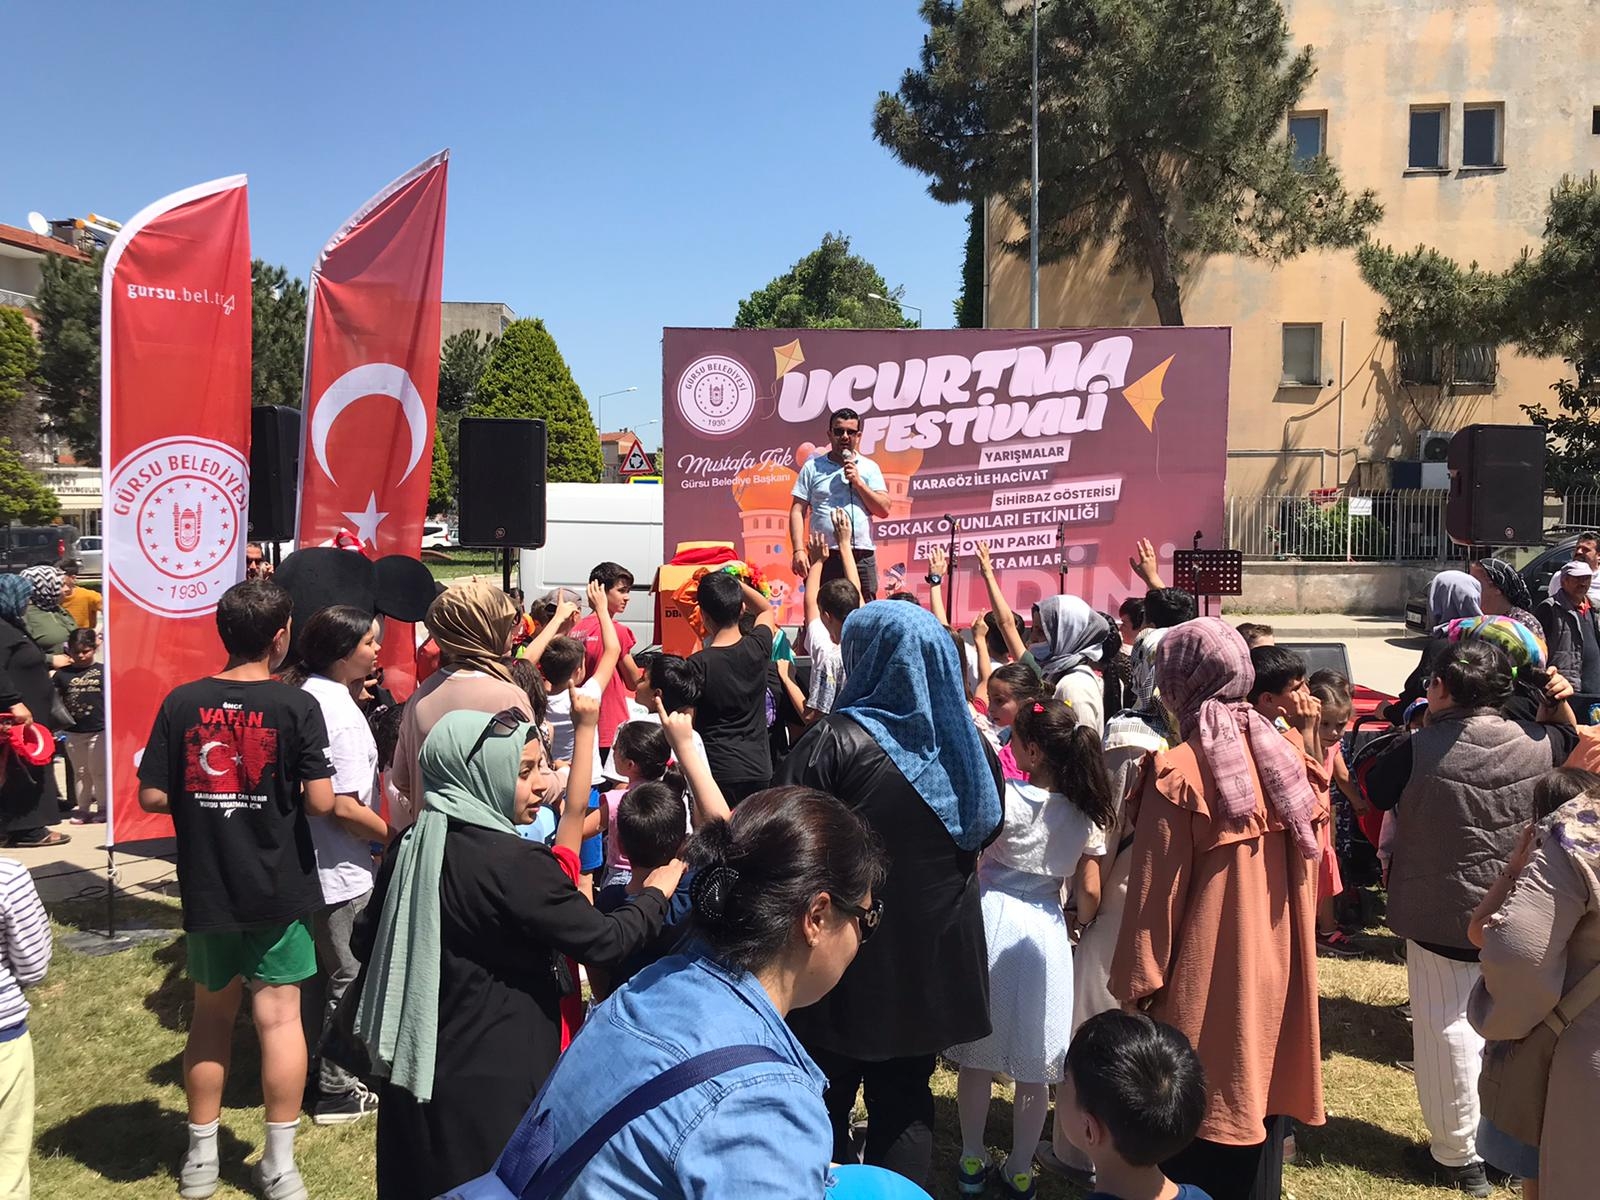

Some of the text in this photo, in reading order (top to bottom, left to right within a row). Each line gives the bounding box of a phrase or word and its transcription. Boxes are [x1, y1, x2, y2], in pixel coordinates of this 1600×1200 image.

[708, 418, 726, 427] 1930
[858, 380, 1109, 455] FESTİVALİ
[677, 449, 757, 478] Mustafa
[984, 446, 1064, 463] YARIŞMALAR
[113, 460, 163, 516] GÜRSU
[681, 473, 791, 490] Gürsu Belediye Başkanı
[912, 468, 1049, 491] KARAGÖZ İLE HACİVAT
[995, 484, 1116, 506] SİHİRBAZ GÖSTERİSİ
[877, 520, 933, 538] SOKAK
[1022, 503, 1099, 525] ETKİNLİĞİ
[1008, 534, 1051, 549] PARKI
[170, 581, 208, 599] 1930
[198, 707, 264, 728] VATAN
